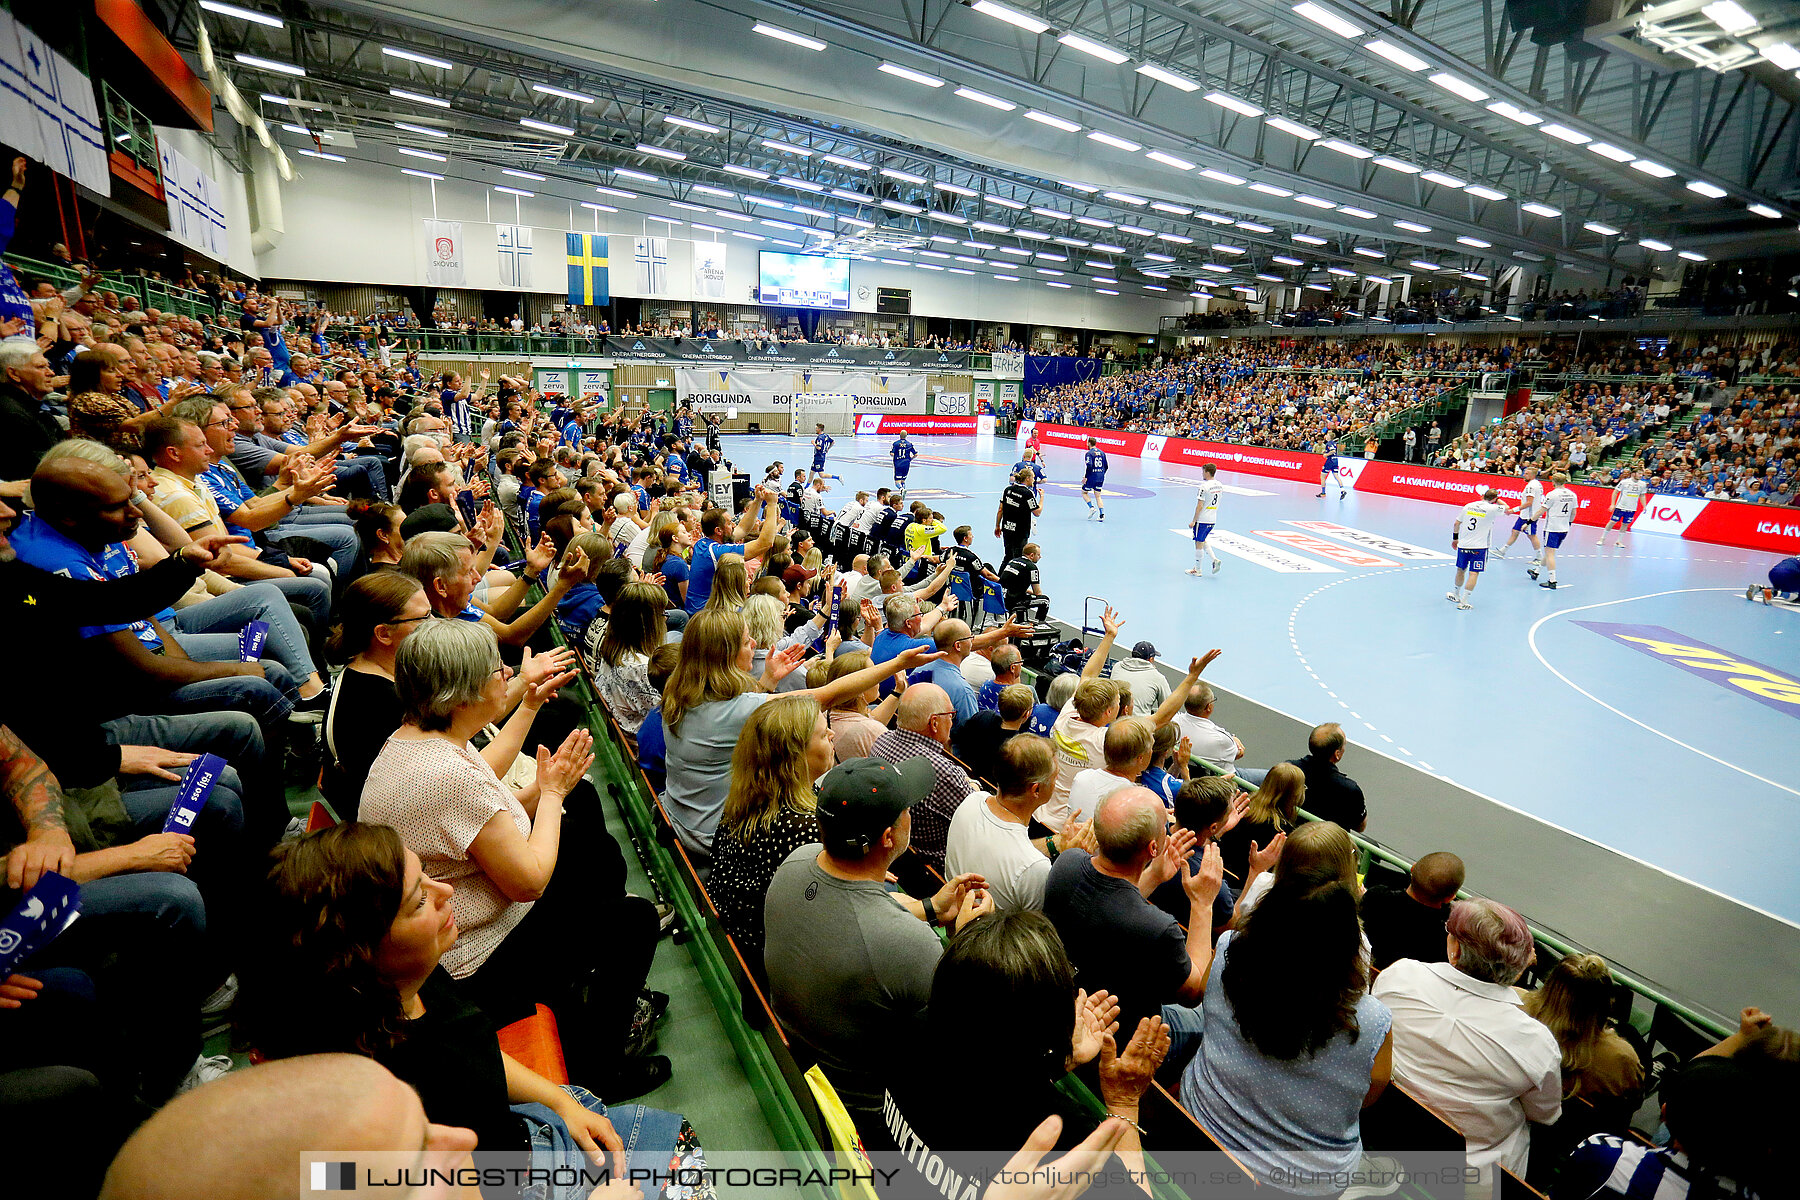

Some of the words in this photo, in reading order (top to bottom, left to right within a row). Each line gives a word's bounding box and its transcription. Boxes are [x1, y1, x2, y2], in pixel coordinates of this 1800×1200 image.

[688, 393, 752, 404] BORGUNDA
[939, 395, 967, 414] SBB
[863, 420, 875, 428] ICA
[1021, 426, 1030, 435] ICA
[1147, 441, 1159, 451] ICA
[1094, 456, 1103, 468] 66
[1192, 449, 1216, 459] KVANTUM
[1216, 451, 1234, 461] BODEN
[1242, 455, 1265, 465] BODENS
[1264, 458, 1296, 470] HANDBOLL
[1296, 462, 1303, 470] IF
[1339, 466, 1354, 478] CA
[715, 483, 731, 495] EY
[1392, 475, 1406, 485] ICA
[1406, 477, 1445, 490] KVANTUM
[1445, 481, 1475, 494] BODEN
[1580, 500, 1590, 509] IF
[1211, 493, 1219, 506] 8
[1561, 502, 1569, 515] 4
[1650, 505, 1683, 524] ICA
[1467, 517, 1478, 531] 3
[1756, 521, 1781, 535] ICA
[196, 771, 213, 789] Följ
[190, 787, 203, 802] oss
